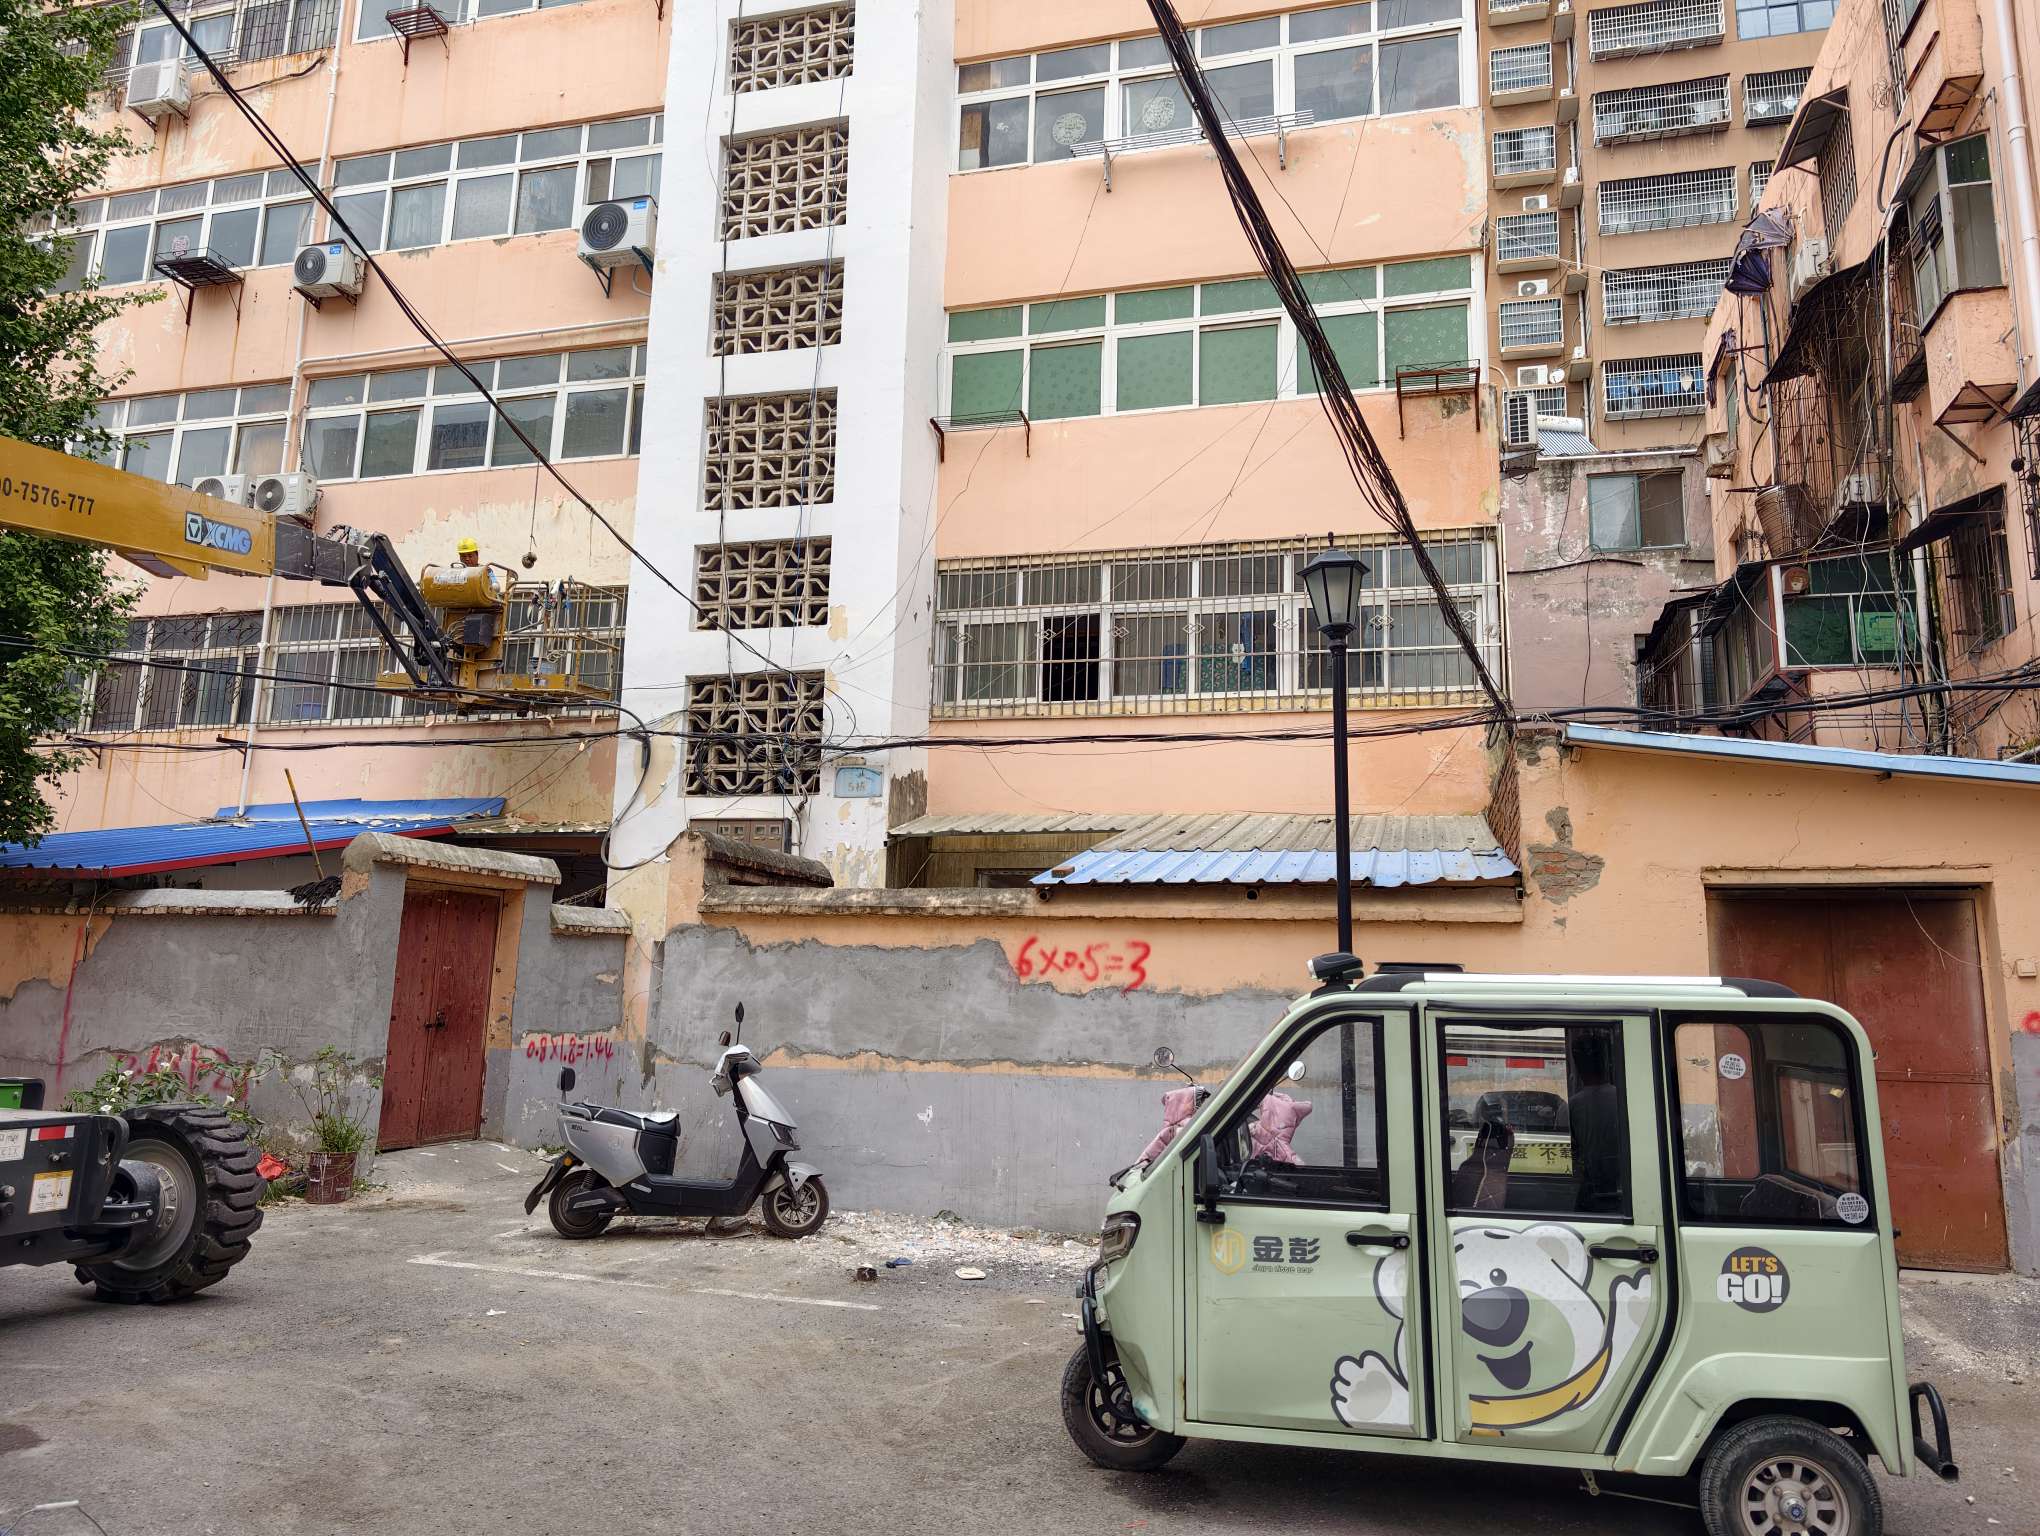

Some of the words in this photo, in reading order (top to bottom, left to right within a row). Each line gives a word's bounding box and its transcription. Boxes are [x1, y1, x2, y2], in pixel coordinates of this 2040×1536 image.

[201, 519, 252, 555] XCMG
[1252, 1235, 1321, 1264] 金彭
[1731, 1256, 1778, 1273] LET'S
[1717, 1273, 1783, 1304] GO!
